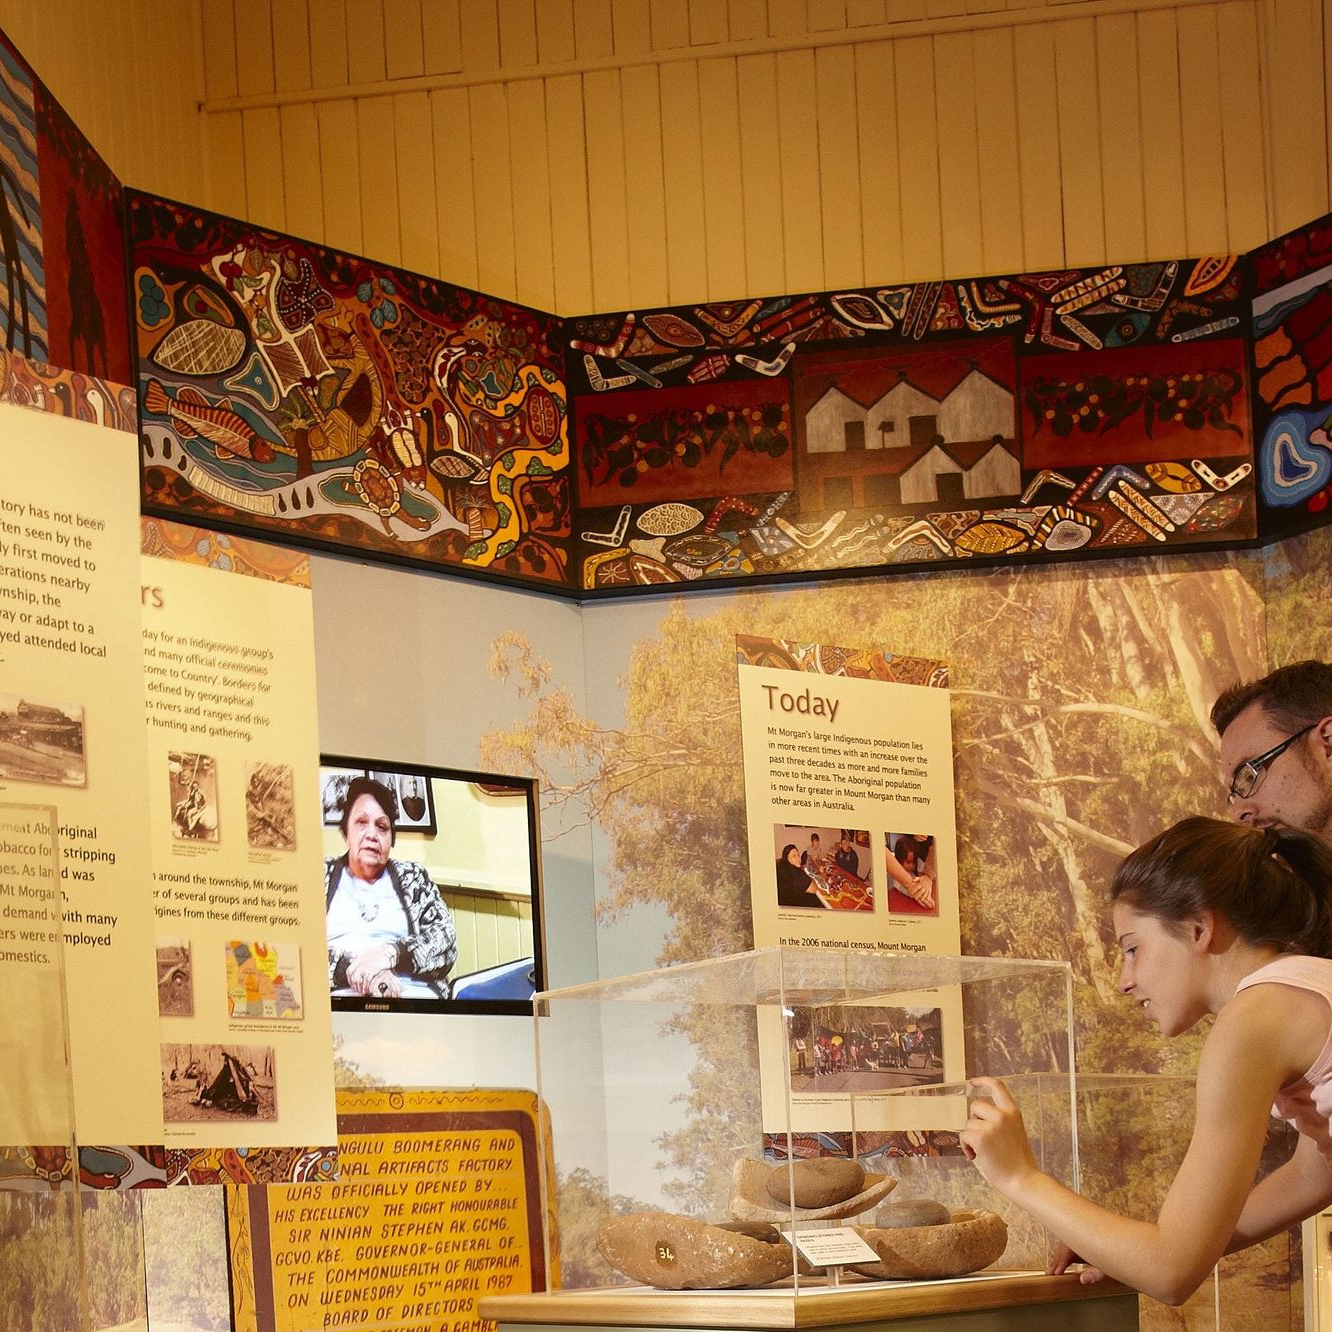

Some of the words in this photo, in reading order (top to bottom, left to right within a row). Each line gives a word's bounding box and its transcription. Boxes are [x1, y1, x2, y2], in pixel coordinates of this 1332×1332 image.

[28, 503, 49, 519] has
[53, 512, 72, 524] not
[76, 513, 105, 531] been
[24, 527, 52, 541] seen
[56, 530, 70, 547] by
[73, 535, 91, 550] the
[12, 543, 37, 560] first
[41, 552, 80, 568] moved
[83, 559, 96, 571] to
[50, 575, 90, 594] nearby
[147, 680, 181, 695] defined
[184, 686, 195, 699] by
[197, 691, 253, 707] geographical
[761, 684, 839, 722] Today
[767, 726, 777, 735] Mt
[778, 727, 811, 739] Morgan's
[813, 730, 831, 742] large
[833, 733, 871, 745] Indigenous
[873, 739, 910, 748] population
[911, 741, 923, 750] lies
[183, 906, 204, 918] from
[206, 909, 229, 920] these
[231, 911, 267, 923] different
[269, 916, 299, 927] groups.
[779, 936, 786, 945] In
[788, 937, 799, 946] the
[801, 937, 819, 946] 2006
[820, 939, 849, 948] national
[850, 941, 876, 950] census,
[877, 941, 899, 950] Mount
[900, 942, 926, 953] Morgan
[338, 1141, 384, 1155] NGULU
[393, 1139, 481, 1154] BOOMERANG
[490, 1137, 516, 1151] AND
[377, 1159, 449, 1174] ARTIFACTS
[458, 1158, 512, 1172] FACTORY
[286, 1185, 322, 1201] WAS
[331, 1182, 408, 1200] OFFICIALLY
[415, 1180, 467, 1195] OPENED
[275, 1209, 295, 1223] HIS
[299, 1205, 369, 1222] EXCELLENCY
[383, 1203, 404, 1216] THE
[410, 1200, 445, 1214] RIGHT
[449, 1197, 518, 1212] HONOURABLE
[288, 1228, 311, 1243] SIR
[319, 1224, 372, 1241] NINIAN
[380, 1221, 444, 1239] STEPHEN
[355, 1237, 491, 1261] GOVERNOR-GENERAL
[659, 1247, 674, 1261] 34
[287, 1270, 315, 1286] THE
[326, 1262, 439, 1284] COMMONWEALTH
[444, 1258, 460, 1274] OF
[287, 1292, 309, 1308] ON
[320, 1284, 404, 1306] WEDNESDAY
[443, 1277, 479, 1293] APRIL
[486, 1274, 513, 1290] 1987
[323, 1308, 368, 1329] BOARD
[375, 1306, 393, 1320] OF
[401, 1297, 473, 1319] DIRECTORS
